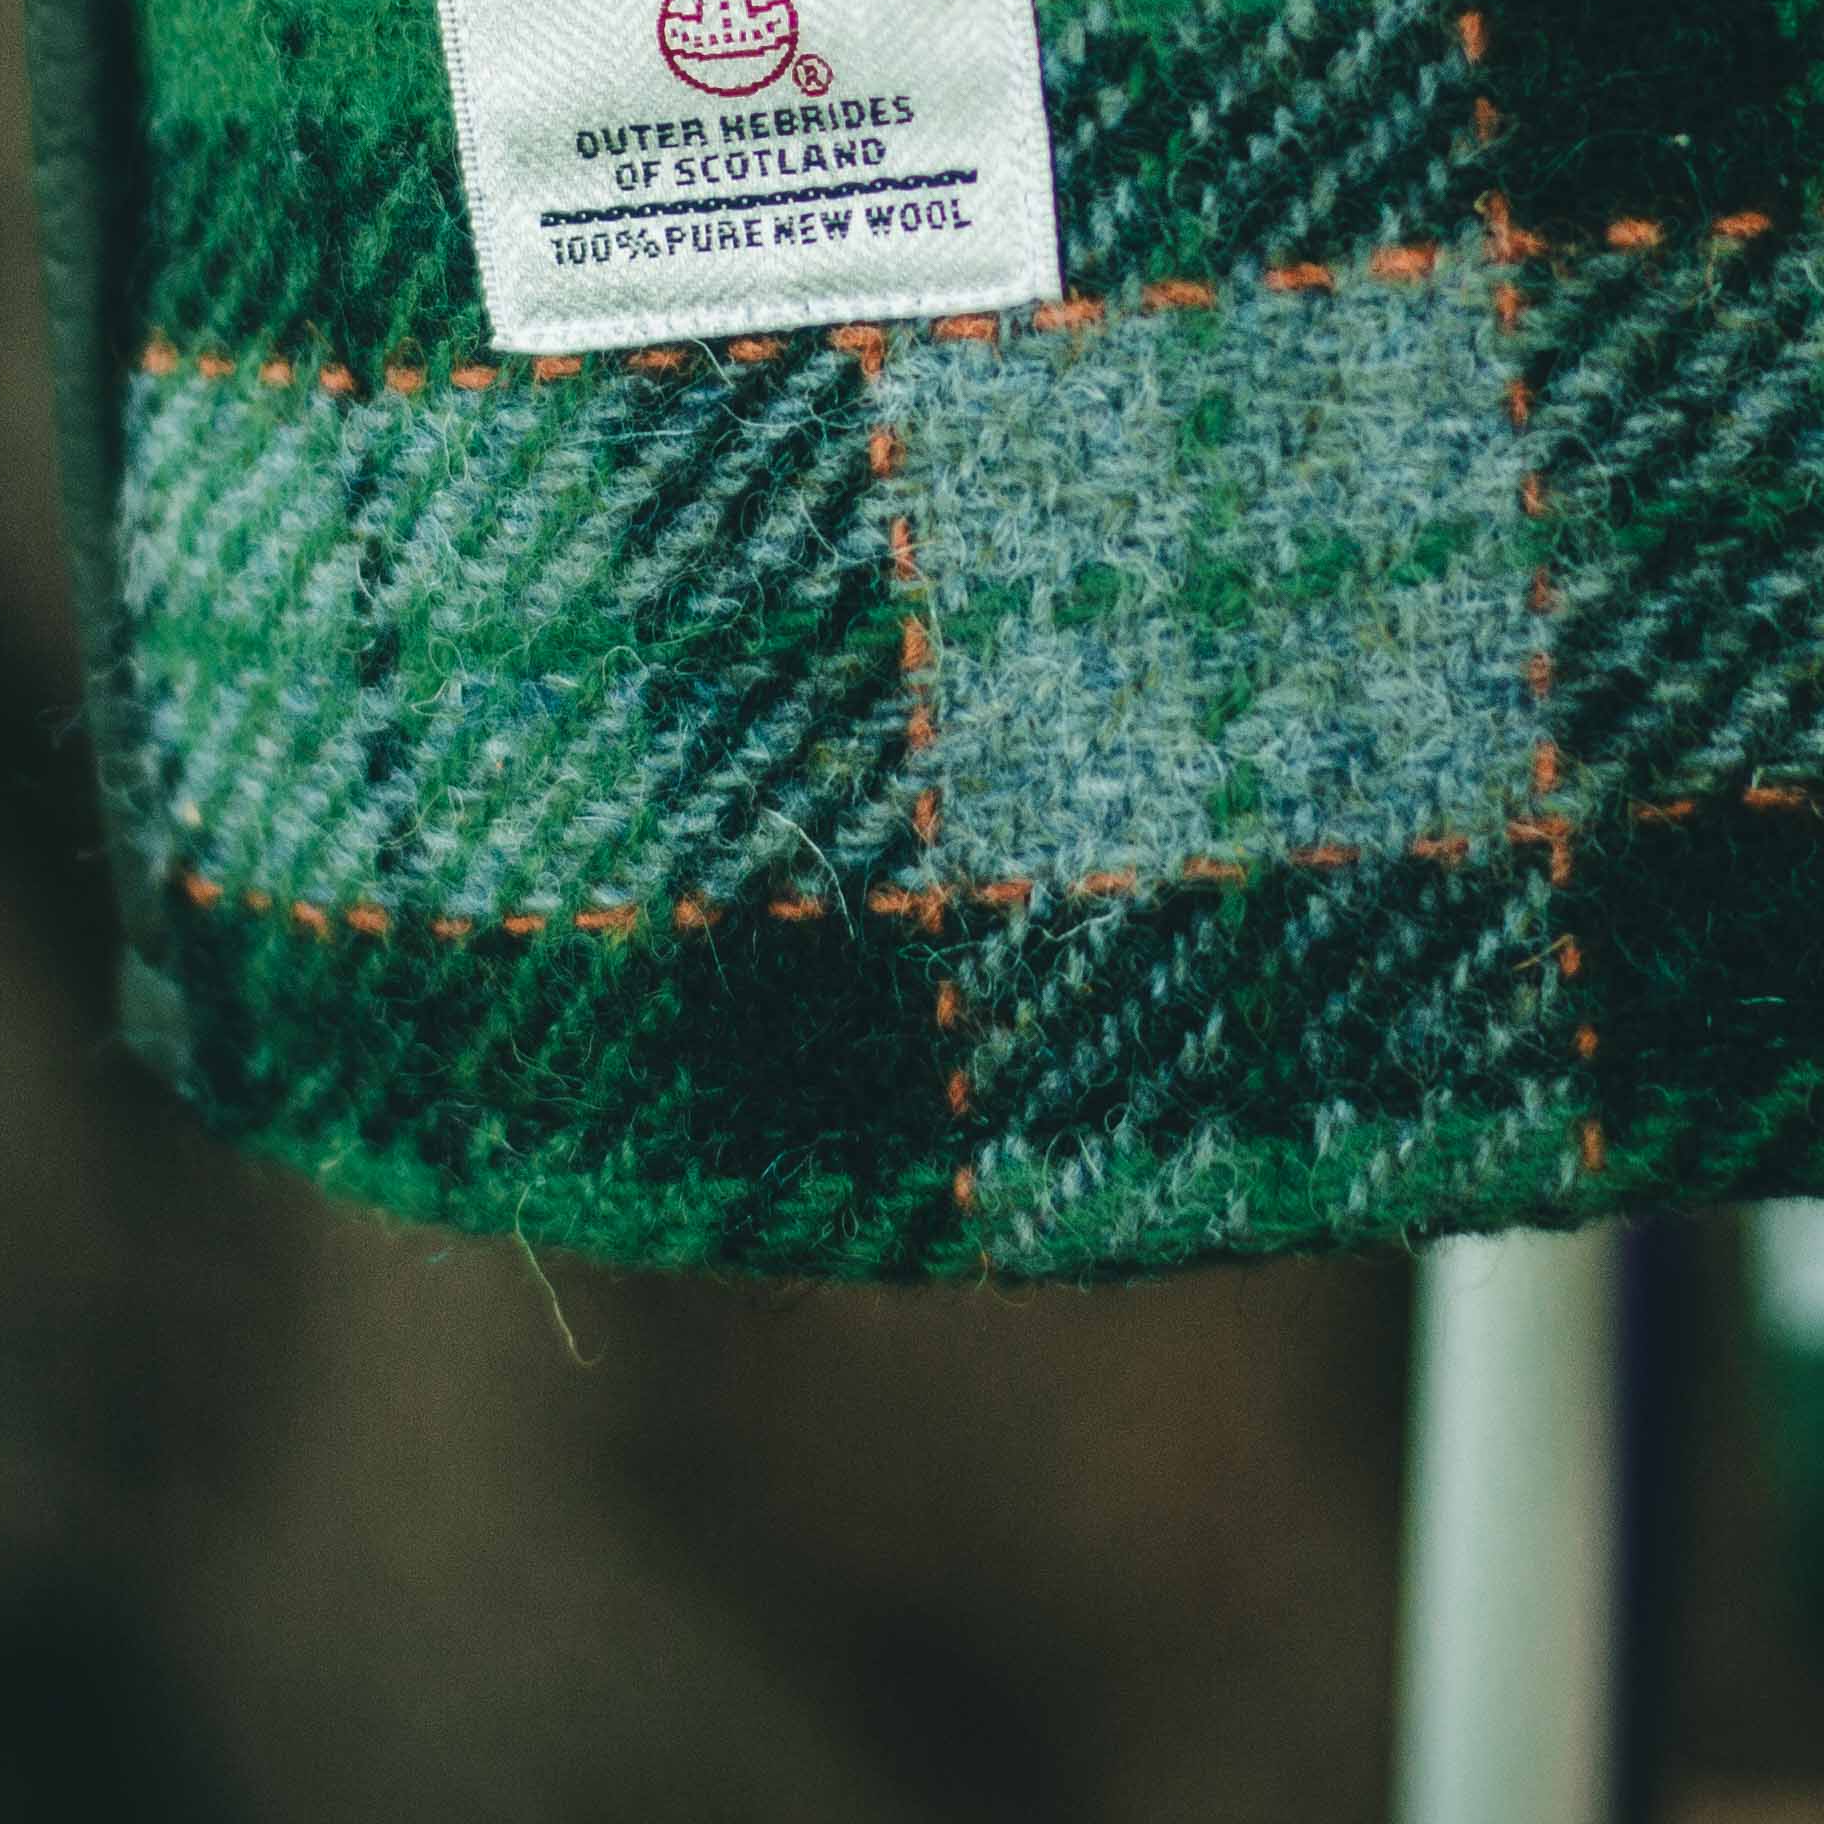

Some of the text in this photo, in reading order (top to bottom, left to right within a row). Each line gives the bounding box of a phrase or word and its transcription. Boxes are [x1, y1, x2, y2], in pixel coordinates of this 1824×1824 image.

[577, 96, 915, 160] OUTER HEBRIDES
[616, 140, 886, 191] OF SCOTLAND
[550, 200, 972, 265] 100% PURE NEW WOOL
